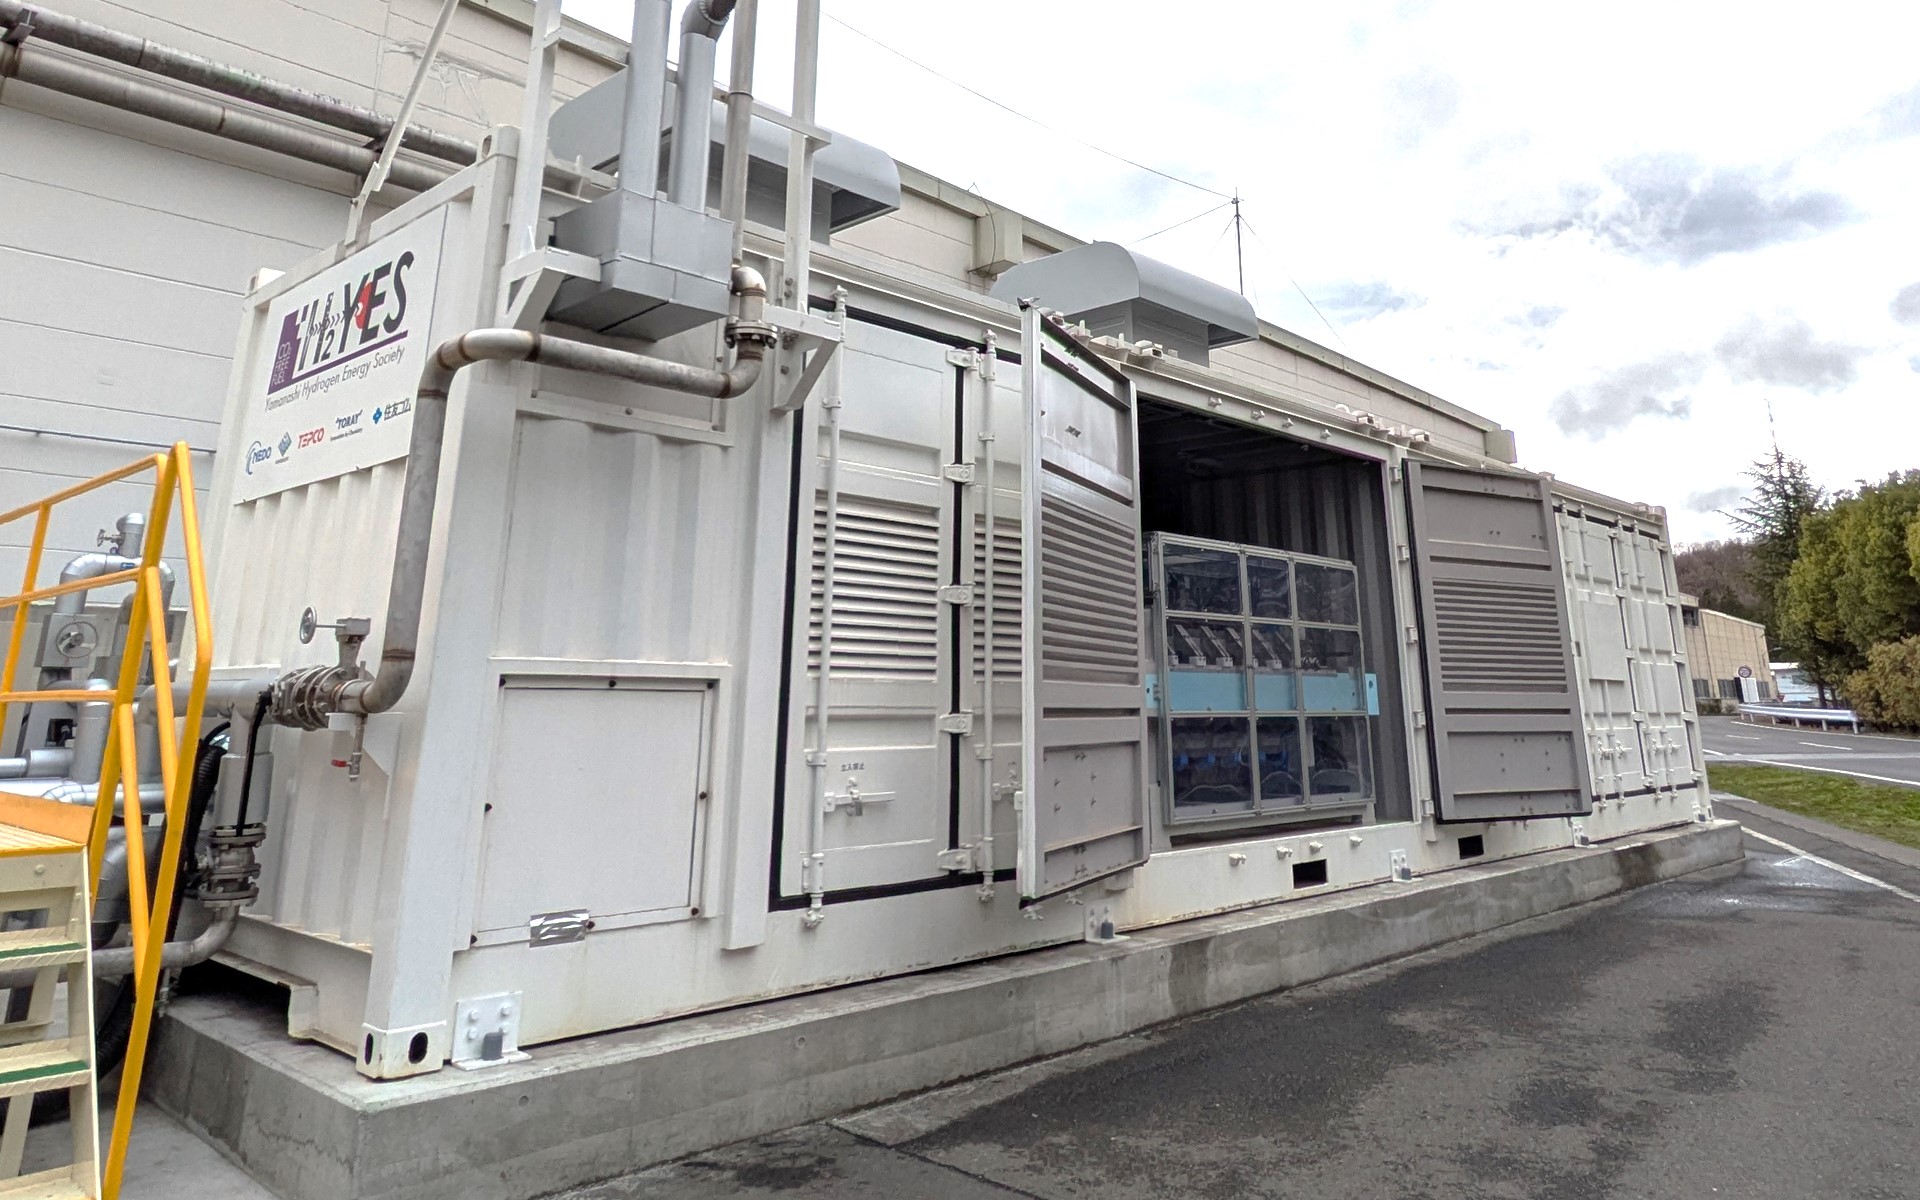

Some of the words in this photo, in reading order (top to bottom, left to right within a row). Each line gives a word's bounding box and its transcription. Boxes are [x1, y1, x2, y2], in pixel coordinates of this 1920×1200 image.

[265, 384, 301, 411] Yamanashi
[302, 372, 340, 400] Hydrogen
[342, 361, 371, 381] Energy
[373, 346, 405, 368] Society
[271, 370, 286, 386] FUEL
[298, 427, 324, 449] TEPCO
[252, 446, 271, 464] NEDO
